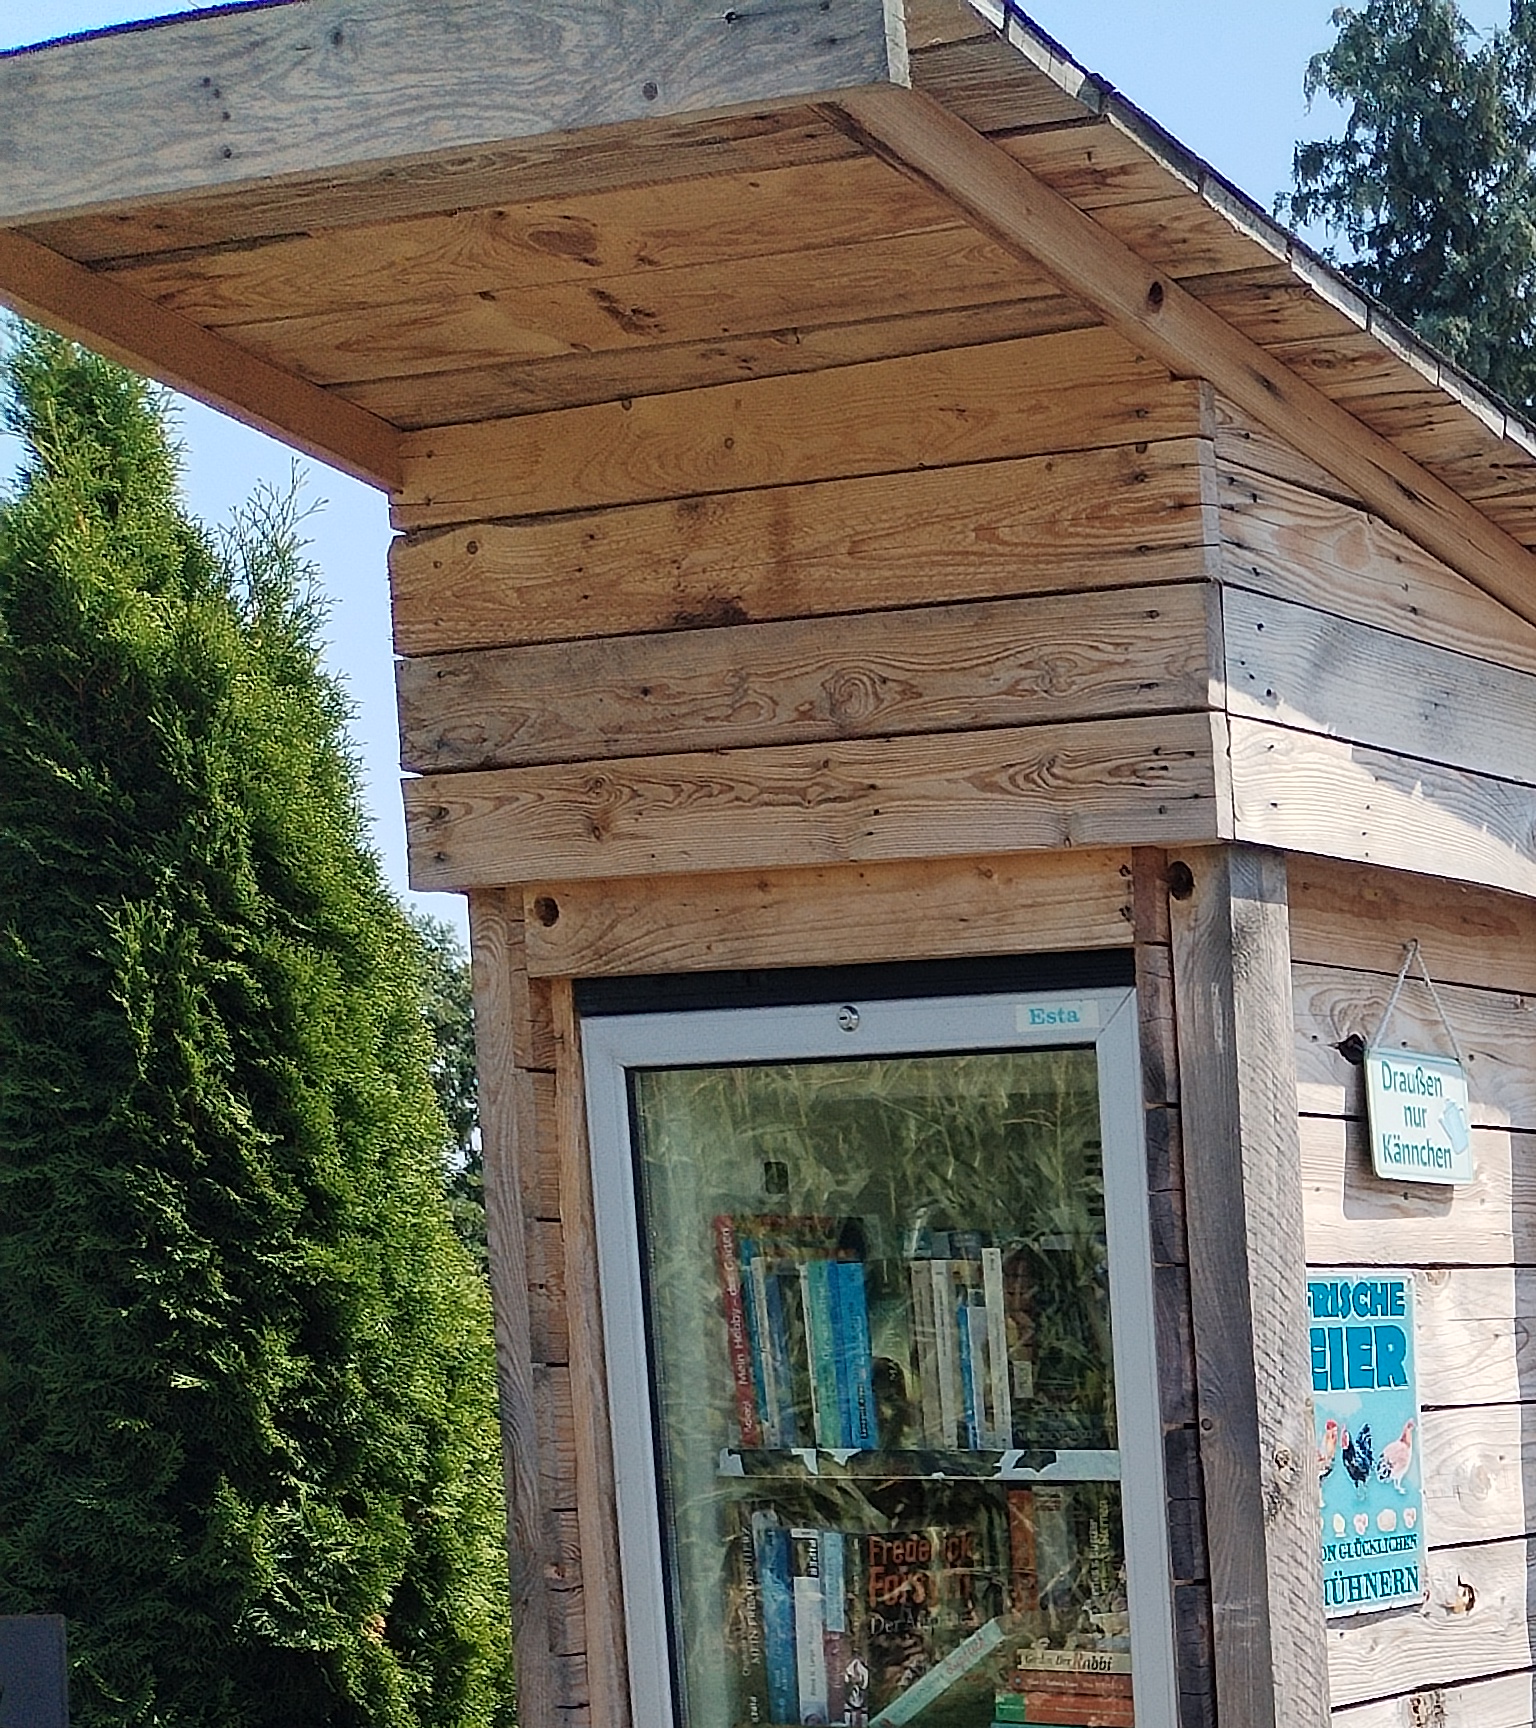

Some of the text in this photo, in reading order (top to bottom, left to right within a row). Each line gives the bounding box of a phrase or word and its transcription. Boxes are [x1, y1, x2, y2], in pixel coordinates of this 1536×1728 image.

[1029, 1008, 1080, 1025] Esta
[1382, 1061, 1443, 1097] Draußen
[1403, 1105, 1427, 1128] nur
[1382, 1133, 1452, 1169] Kännchen
[1322, 1534, 1418, 1561] ON GLÜCKLICHEN
